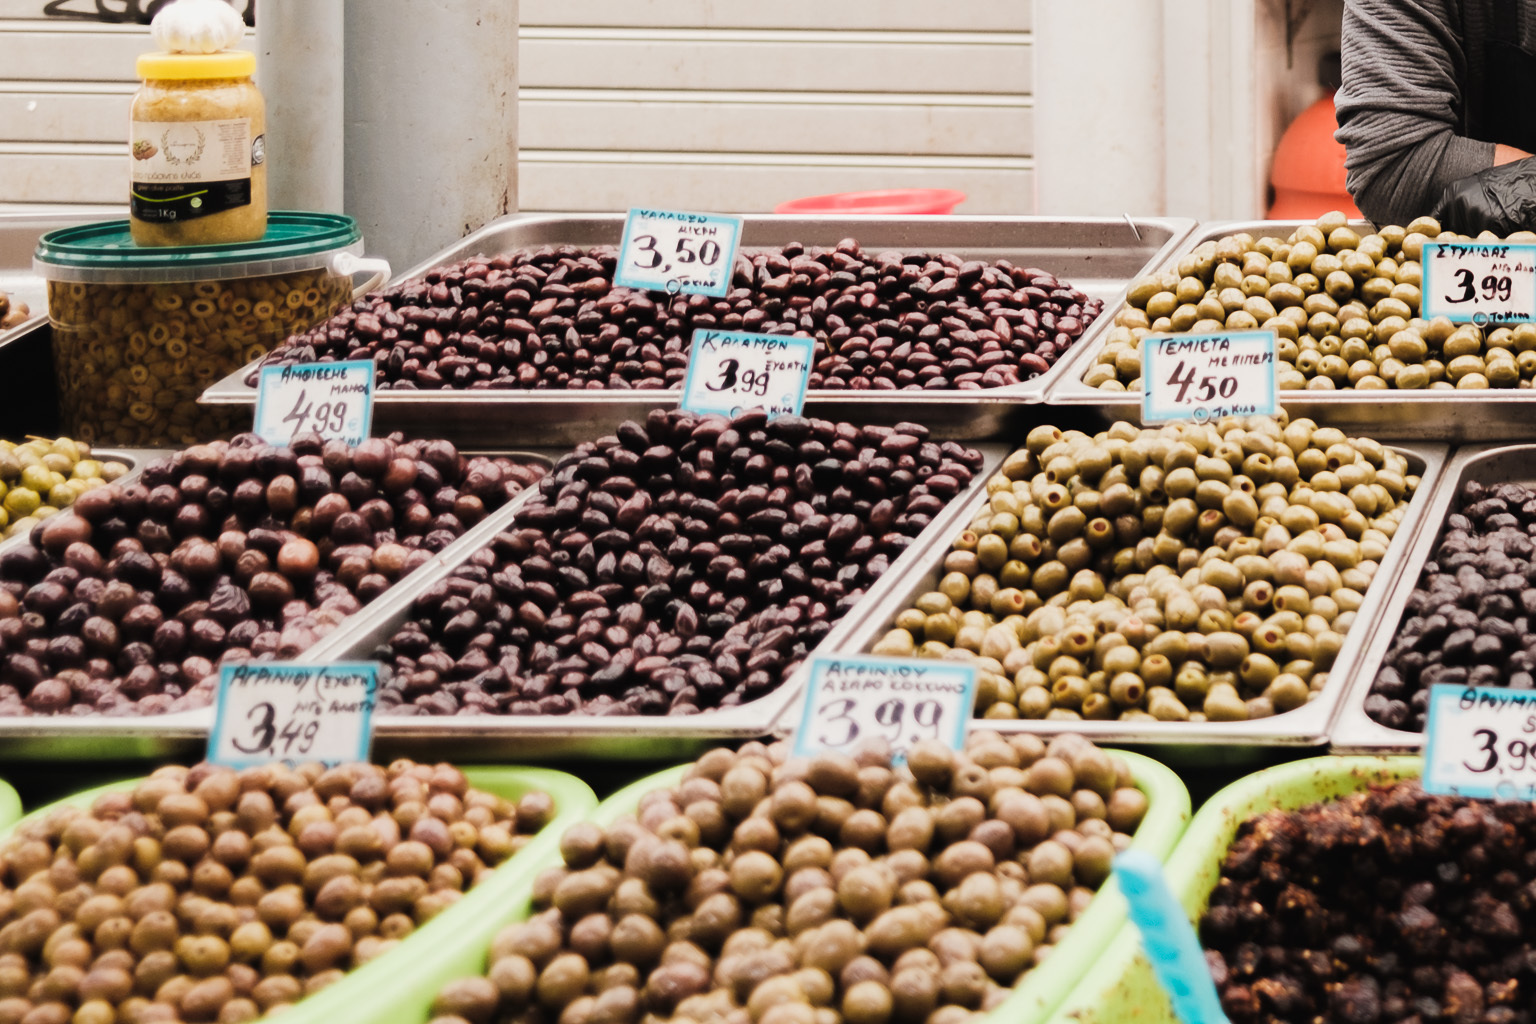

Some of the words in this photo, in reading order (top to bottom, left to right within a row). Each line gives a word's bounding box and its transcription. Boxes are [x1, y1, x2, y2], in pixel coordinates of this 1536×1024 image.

[633, 235, 721, 273] 3,50
[1159, 337, 1230, 355] ΓΕΜΙΣΤΑ
[1166, 360, 1238, 404] 4,50
